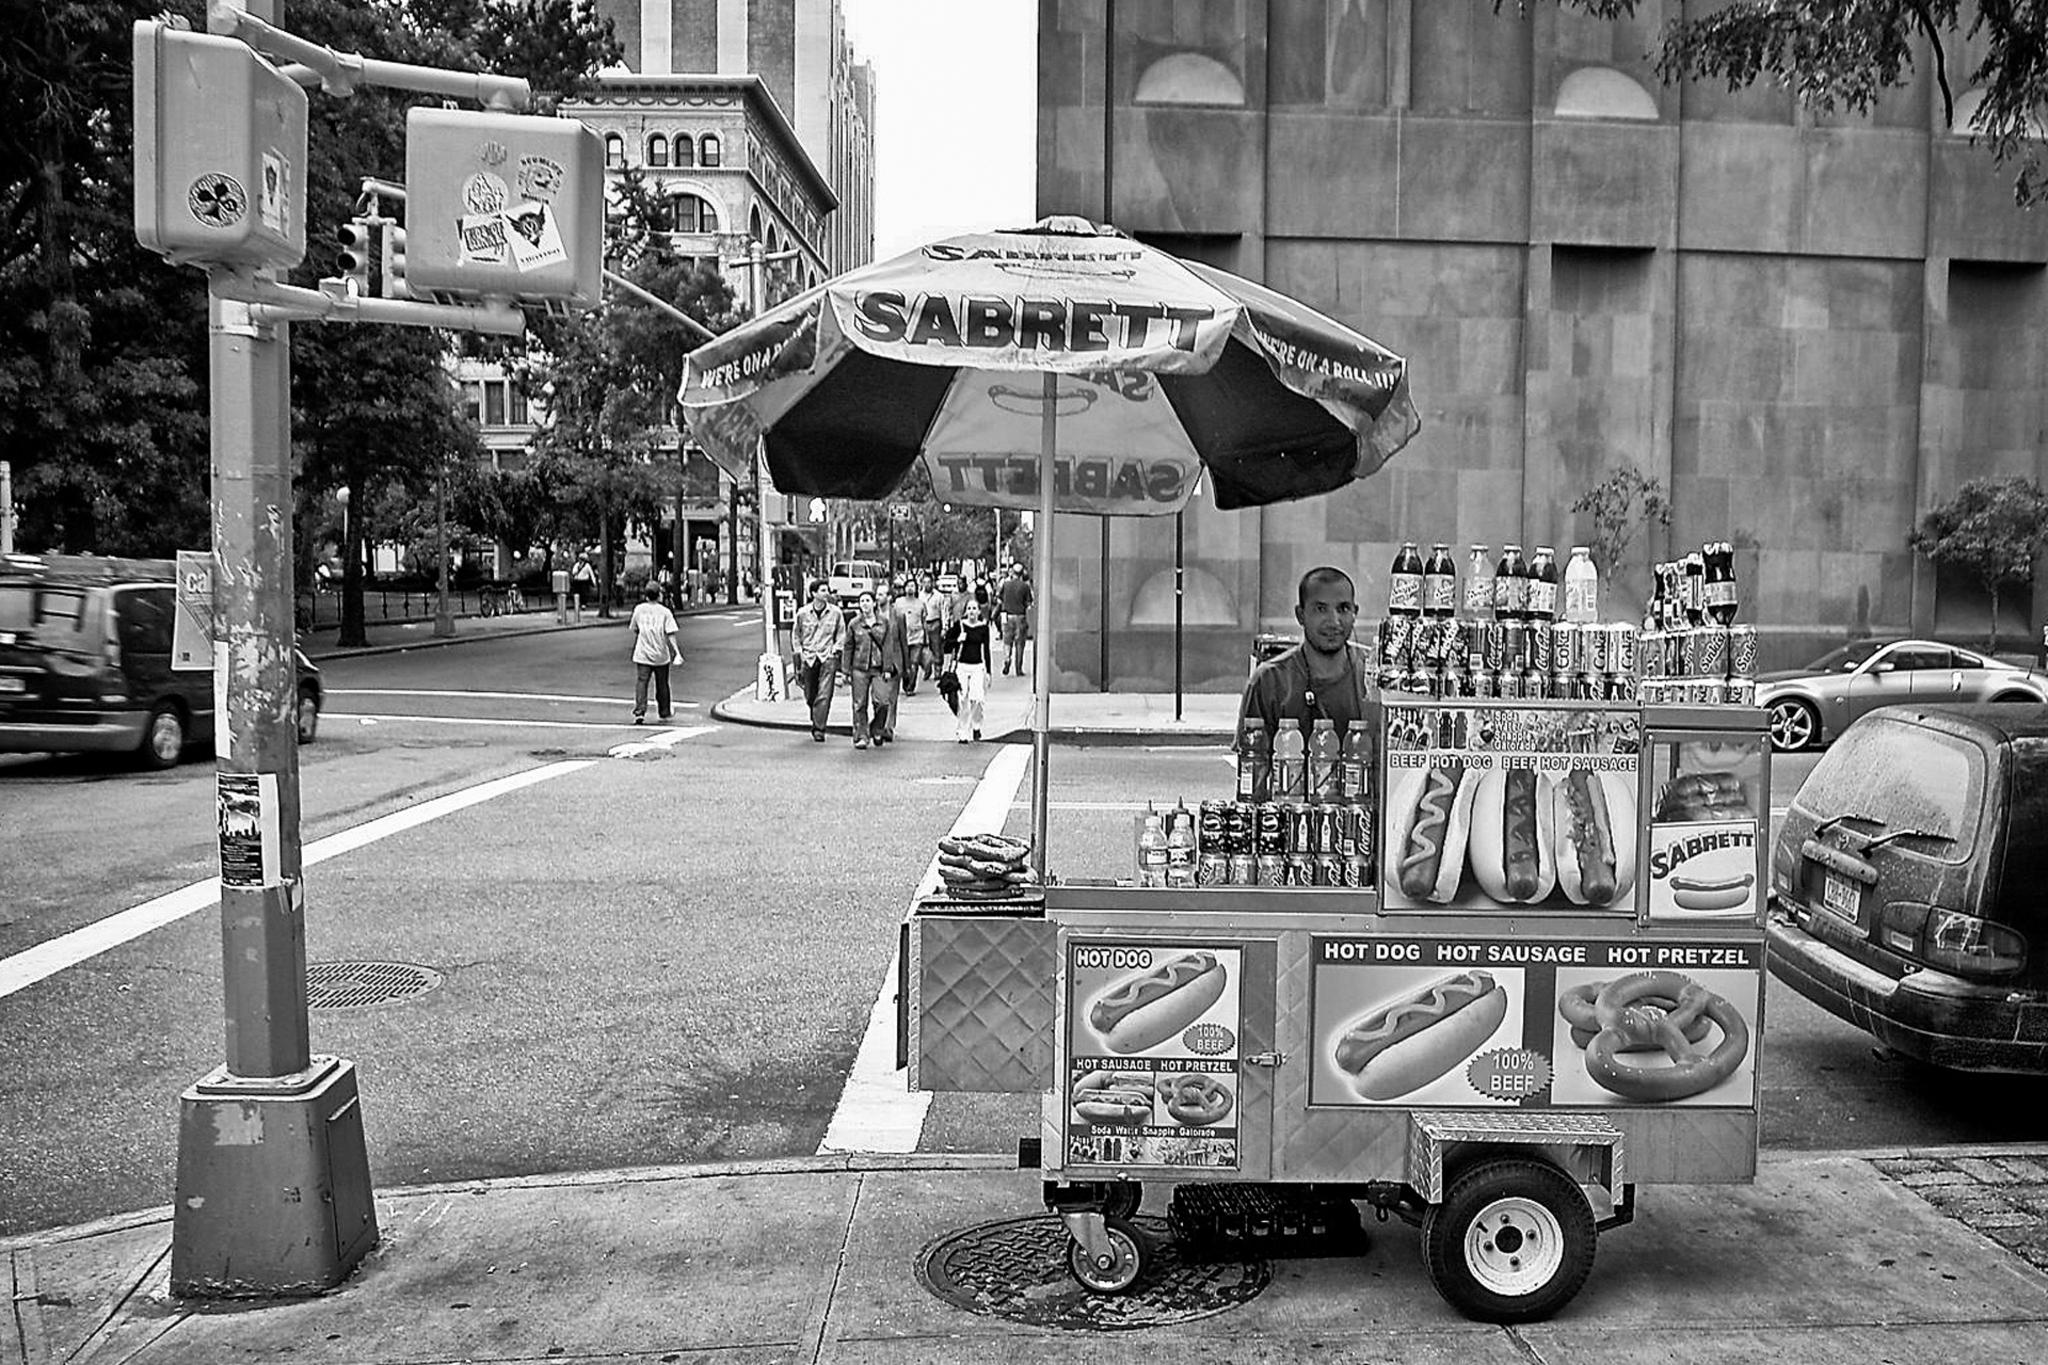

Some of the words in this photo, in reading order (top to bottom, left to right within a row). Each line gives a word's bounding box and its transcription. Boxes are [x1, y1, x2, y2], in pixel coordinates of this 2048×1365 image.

[921, 244, 1144, 262] SABRETT
[854, 289, 1215, 353] SABRETT
[701, 357, 741, 389] WE'RE
[742, 351, 761, 376] ON
[1297, 350, 1318, 373] ON
[1318, 358, 1330, 376] A
[1333, 362, 1372, 386] ROLL
[1556, 629, 1570, 669] Coke
[1594, 629, 1606, 670] Coke
[1621, 630, 1634, 670] Coke
[1390, 754, 1426, 769] BEEF
[1429, 754, 1461, 769] HOT
[1462, 755, 1493, 769] DOG
[1501, 754, 1537, 770] BEEF
[1540, 756, 1570, 771] HOT
[1572, 757, 1638, 772] SAUSAGE
[1651, 830, 1754, 880] SABRETT
[1076, 949, 1112, 968] HOT
[1113, 949, 1152, 969] DOG
[1324, 943, 1369, 959] HOT
[1375, 944, 1421, 960] DOG
[1437, 945, 1481, 961] HOT
[1487, 945, 1586, 963] SAUSAGE
[1607, 947, 1651, 963] HOT
[1657, 948, 1749, 965] PRETZEL
[1198, 1026, 1224, 1038] 100%
[1197, 1039, 1224, 1050] BEEF
[1076, 1059, 1099, 1070] HOT
[1101, 1059, 1151, 1071] SAUSAGE
[1160, 1061, 1184, 1072] HOT
[1185, 1061, 1233, 1072] PRETZEL
[1493, 1053, 1534, 1071] 100%
[1491, 1074, 1534, 1091] BEEF
[1091, 1126, 1111, 1135] Soda
[1142, 1126, 1176, 1138] Snapple
